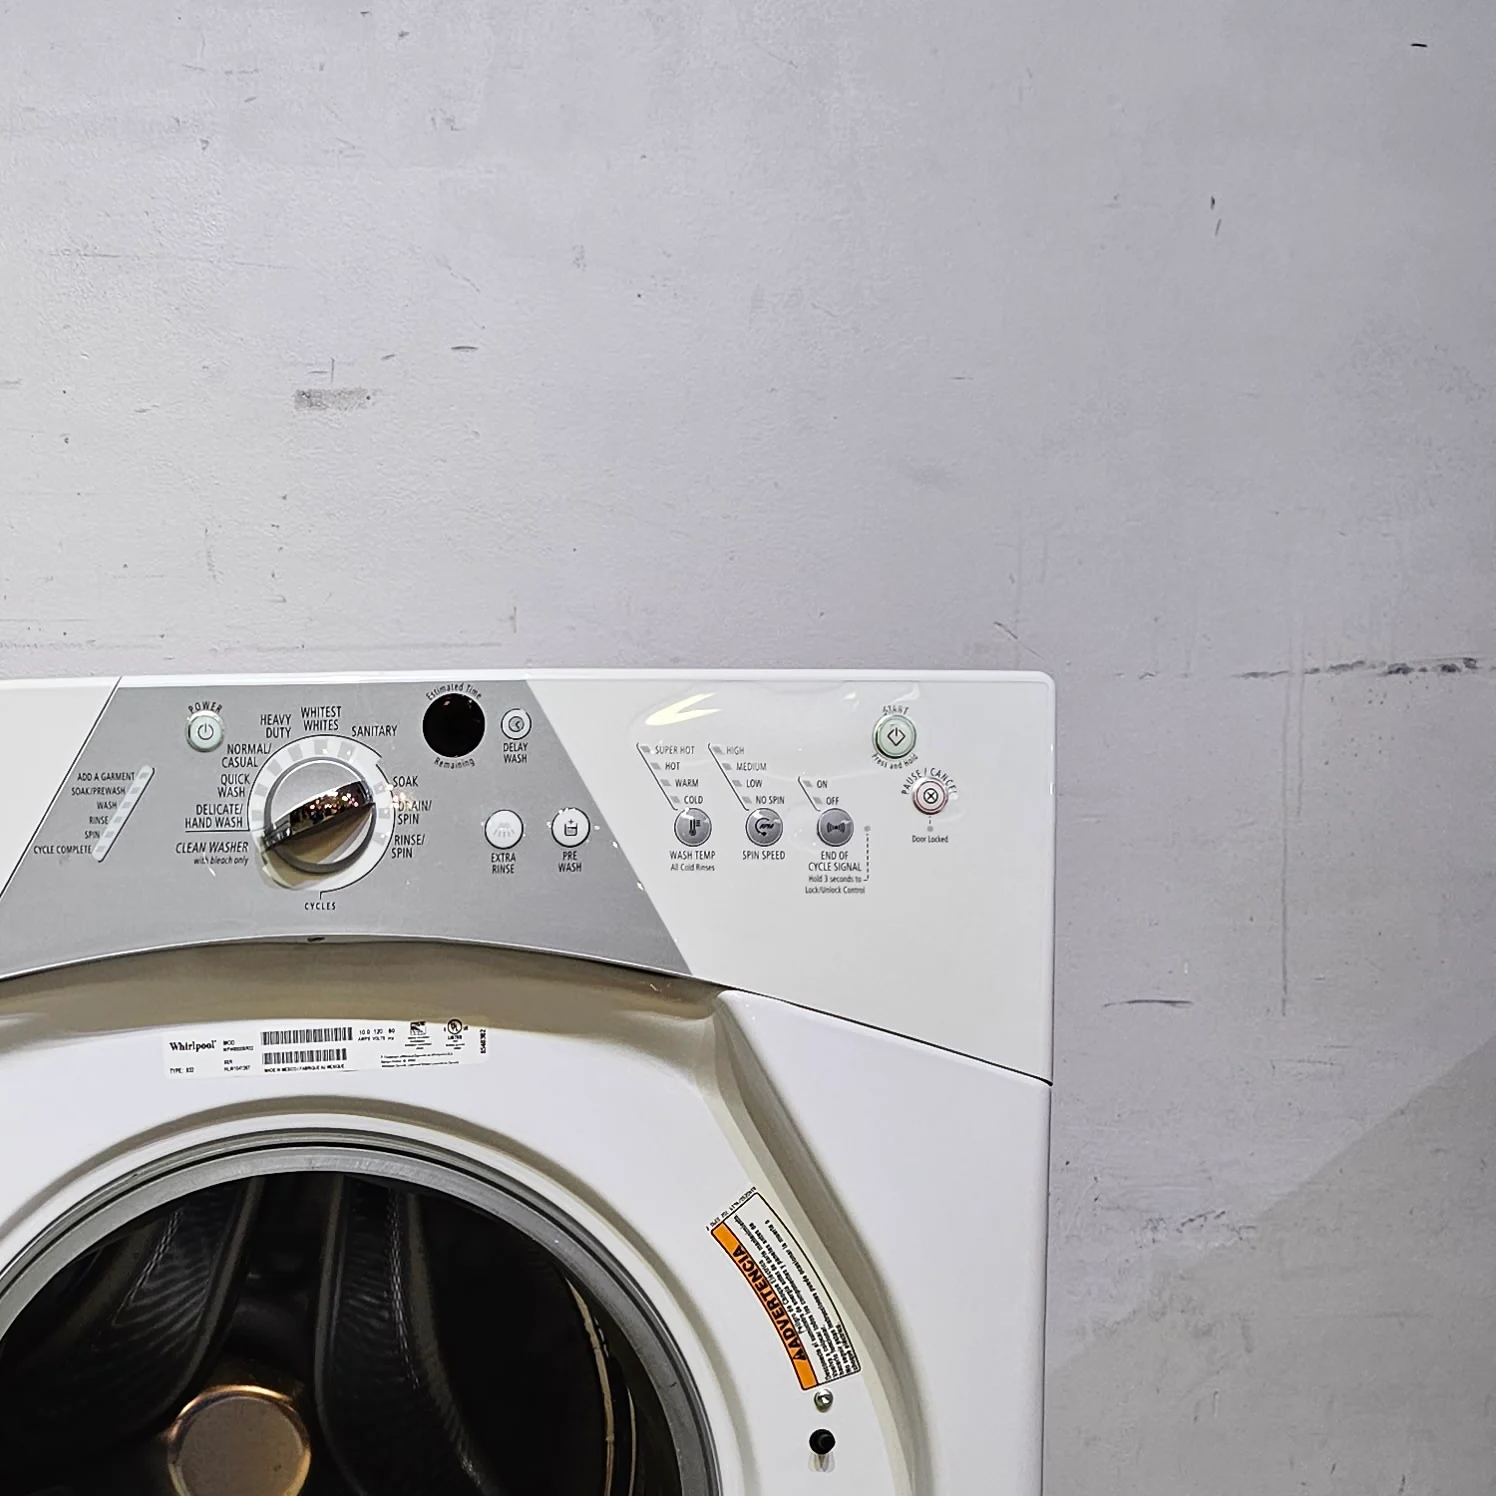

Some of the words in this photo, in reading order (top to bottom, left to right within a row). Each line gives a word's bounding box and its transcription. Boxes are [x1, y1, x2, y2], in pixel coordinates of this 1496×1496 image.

[425, 682, 464, 700] Estimated
[465, 685, 482, 700] Time
[189, 702, 223, 715] POWER
[300, 706, 342, 720] WHITEST
[260, 714, 291, 727] HEAVY
[303, 718, 339, 732] WHITES
[266, 726, 291, 738] DUTY
[351, 724, 397, 738] SANITARY
[227, 743, 271, 756] NORMAL/
[503, 742, 529, 752] DELAY
[655, 746, 677, 755] SUPER
[679, 746, 695, 754] HOT
[726, 746, 744, 755] HIGH
[222, 755, 257, 768] CASUAL
[434, 757, 475, 770] Remaining
[504, 752, 527, 764] WASH
[871, 753, 888, 768] Press
[890, 761, 903, 769] and
[665, 762, 680, 771] HOT
[736, 762, 767, 771] MEDIUM
[78, 771, 92, 781] ADD
[94, 772, 99, 781] A
[101, 771, 135, 782] GARMENT
[220, 773, 250, 786] QUICK
[393, 775, 418, 788] SOAK
[901, 770, 922, 794] PAUSE
[675, 779, 699, 787] WARM
[746, 779, 762, 788] LOW
[816, 780, 828, 788] ON
[71, 785, 126, 796] SOAK/PREWASH
[217, 785, 245, 798] WASH
[684, 796, 702, 804] COLD
[756, 796, 766, 804] NO
[768, 796, 785, 805] SPIN
[826, 797, 839, 805] OFF
[97, 801, 117, 811] WASH
[196, 803, 243, 816] DELICATE/
[89, 815, 109, 826] RINSE
[185, 817, 212, 829] HAND
[215, 817, 243, 828] WASH
[398, 812, 419, 825] SPIN
[85, 830, 100, 840] SPIN
[394, 834, 425, 847] RINSE/
[912, 835, 926, 843] Door
[928, 835, 948, 844] Locked
[34, 844, 54, 855] CYCLE
[56, 844, 92, 856] COMPLETE
[176, 842, 206, 854] CLEAN
[207, 840, 249, 854] WASHER
[392, 846, 413, 858] SPIN
[491, 854, 516, 863] EXTRA
[562, 852, 578, 861] PRE
[670, 851, 692, 860] WASH
[695, 850, 715, 860] TEMP
[743, 851, 759, 860] SPIN
[762, 851, 785, 860] SPEED
[821, 852, 835, 860] END
[836, 852, 848, 860] OF
[209, 856, 230, 865] bleach
[232, 856, 248, 866] only
[492, 864, 515, 874] RINSE
[558, 862, 582, 872] WASH
[680, 863, 695, 871] Cold
[808, 863, 832, 872] CYCLE
[833, 863, 862, 872] SIGNAL
[824, 875, 828, 883] 3
[805, 886, 842, 894] Lock/Unlock
[844, 886, 865, 894] Control
[304, 902, 336, 911] CYCLES
[169, 1040, 216, 1052] Whirlpool
[732, 1244, 803, 1350] ADVERTENCIA
